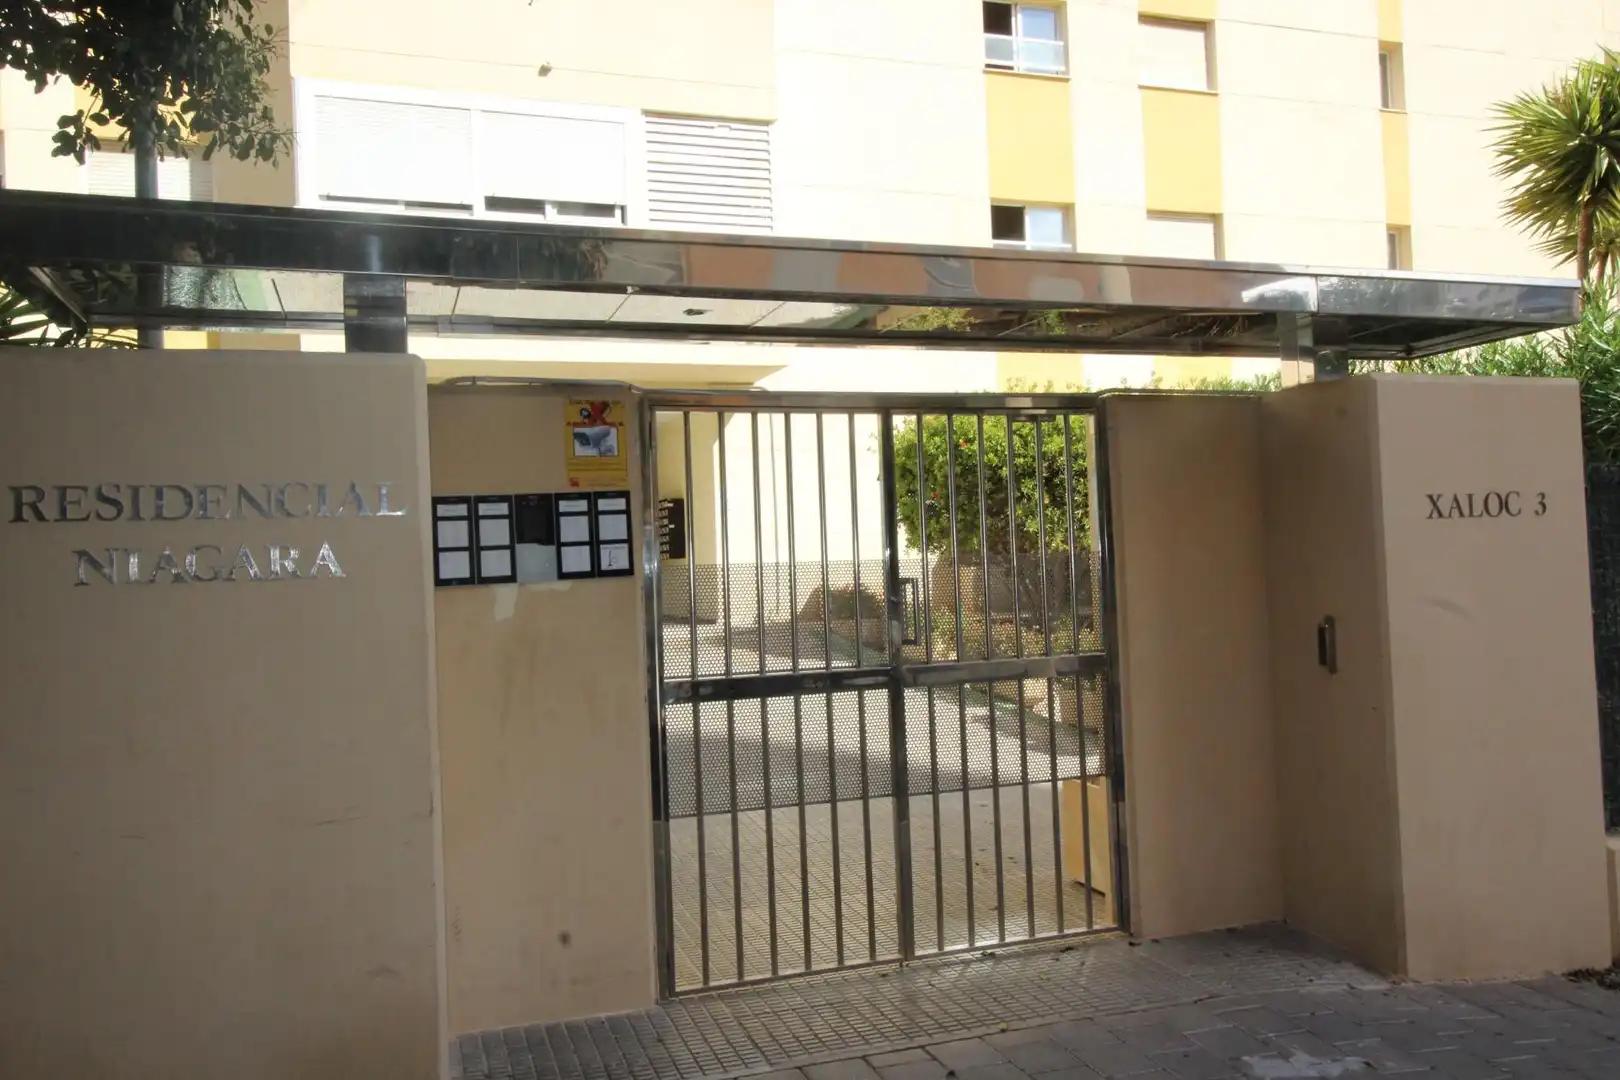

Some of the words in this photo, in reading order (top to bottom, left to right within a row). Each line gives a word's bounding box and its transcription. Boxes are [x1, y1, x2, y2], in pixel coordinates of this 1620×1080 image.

[7, 481, 408, 523] RESIDENCIAL
[1425, 490, 1521, 519] XALOC
[1534, 492, 1547, 516] 3
[71, 541, 346, 587] NIAGARA
